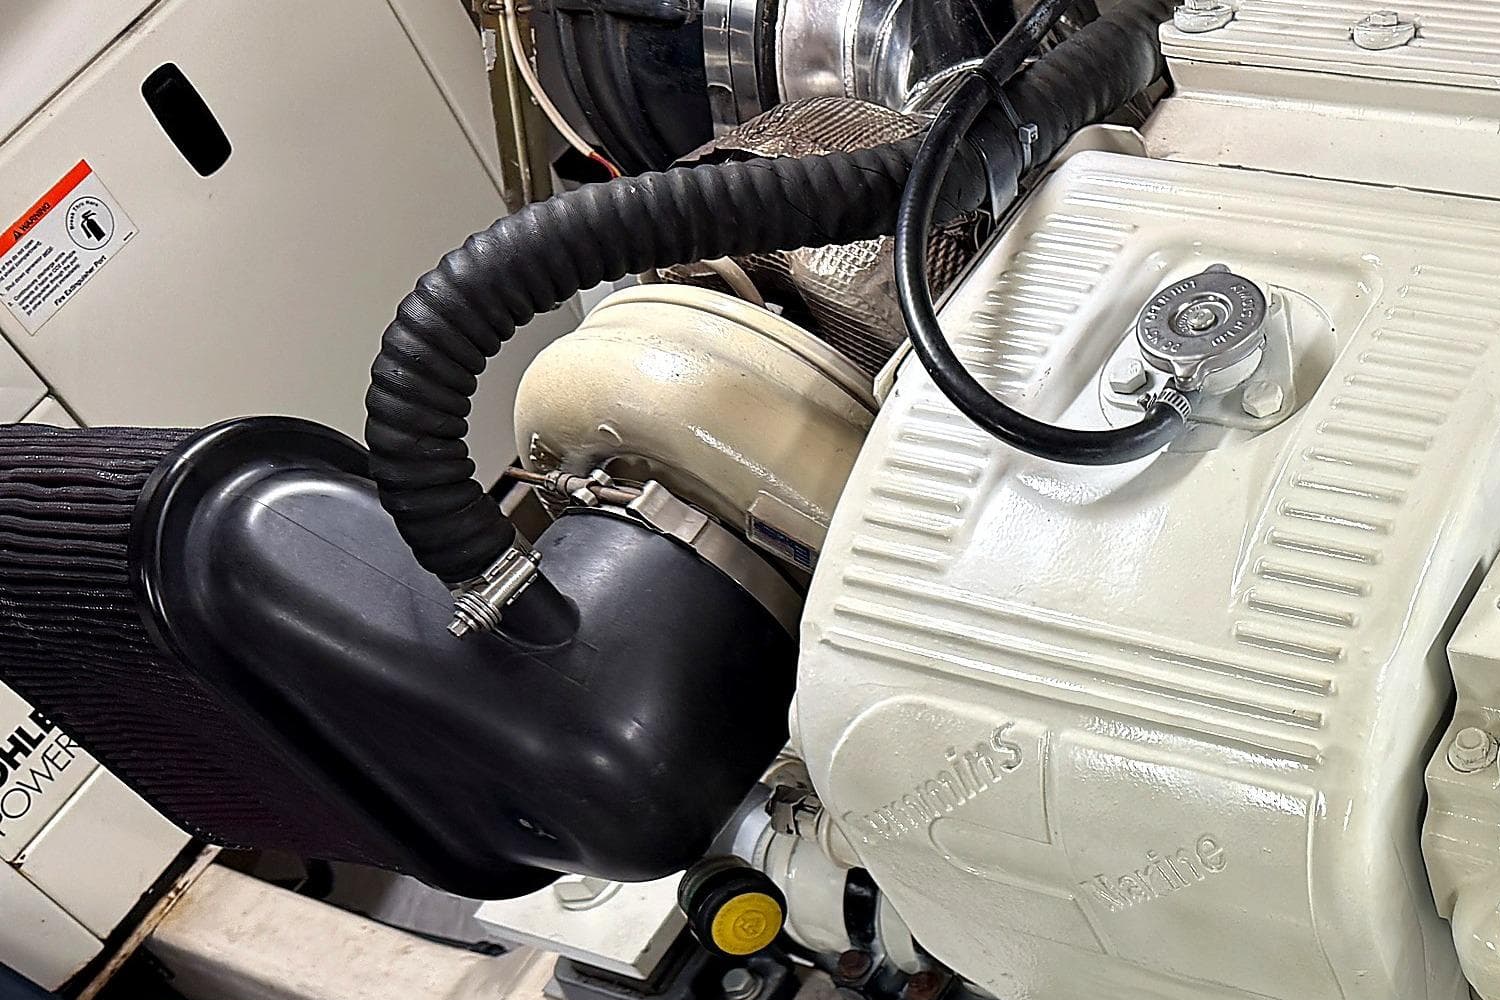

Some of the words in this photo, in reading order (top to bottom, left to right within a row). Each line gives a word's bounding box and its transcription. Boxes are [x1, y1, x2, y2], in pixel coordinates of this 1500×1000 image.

[20, 202, 50, 231] WARNING
[53, 294, 65, 306] Fire
[63, 265, 95, 296] Extinguisher
[93, 254, 106, 267] Port
